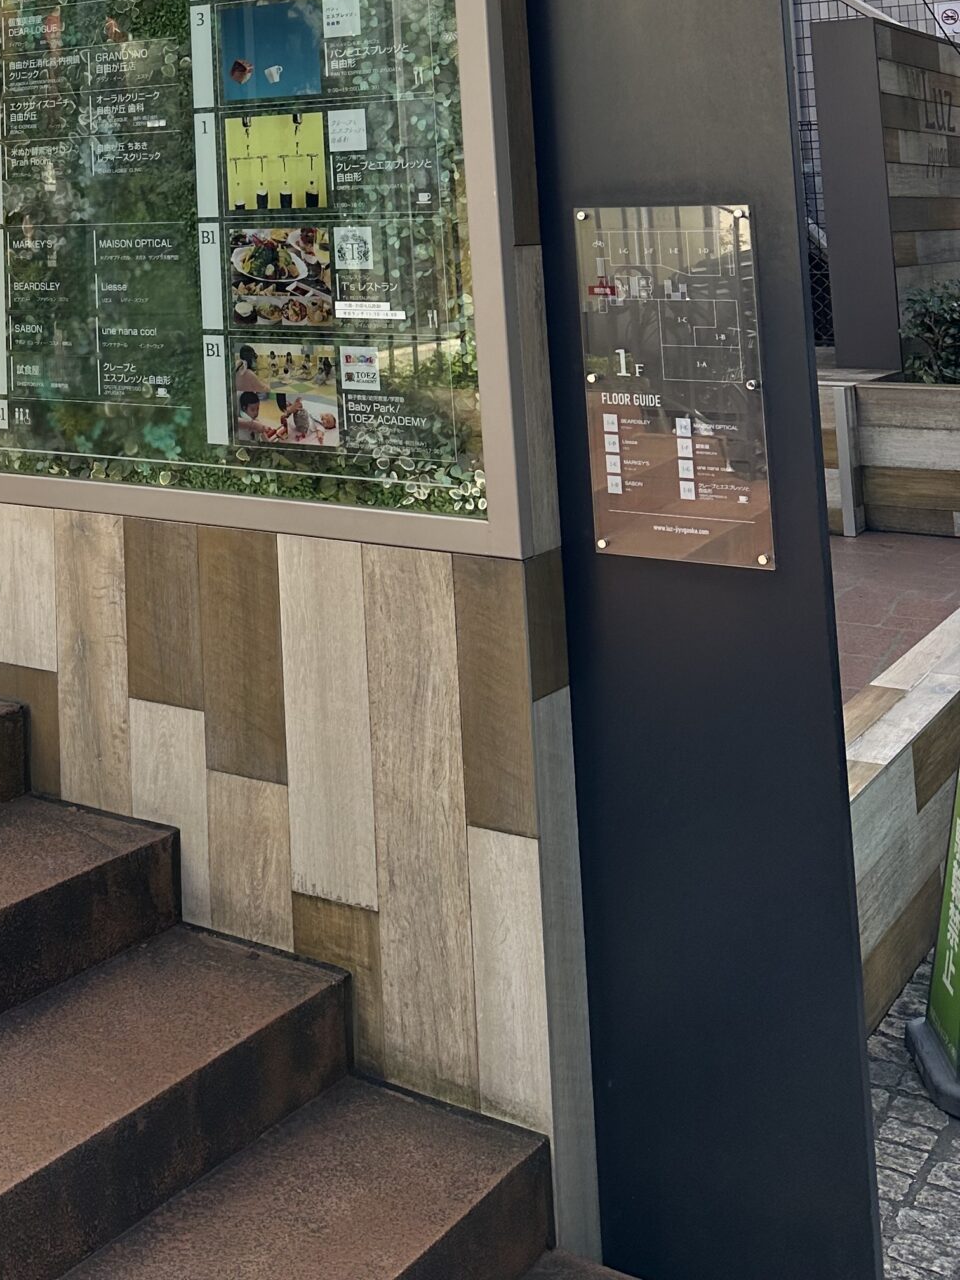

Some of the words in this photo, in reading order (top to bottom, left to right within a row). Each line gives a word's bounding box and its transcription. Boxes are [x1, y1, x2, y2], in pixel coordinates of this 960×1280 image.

[196, 12, 205, 26] 3
[330, 43, 410, 59] パンとエスプレッソと
[96, 62, 136, 75] 自由が丘店
[330, 58, 356, 69] 自由形
[9, 70, 39, 81] クリニック
[96, 91, 160, 105] オーラルクリニーク
[9, 98, 71, 111] エクササイズコーチ
[97, 104, 126, 116] 自由が丘
[128, 103, 144, 114] 歯科
[10, 111, 37, 122] 自由が丘
[202, 121, 208, 134] 1
[127, 141, 147, 152] ちあき
[336, 159, 432, 172] クレープとエスプレッソと
[336, 172, 362, 183] 自由形
[99, 239, 133, 249] MAISON
[134, 238, 173, 249] OPTICAL
[201, 231, 216, 245] B1
[13, 239, 53, 250] MARKEY'S
[13, 281, 61, 292] BEARDSLEY
[101, 282, 127, 292] Liesse
[342, 281, 355, 291] T's
[358, 281, 398, 293] レストラン
[14, 323, 43, 334] SABON
[102, 328, 116, 336] une
[118, 327, 138, 336] nana
[139, 327, 158, 337] cool
[206, 343, 222, 358] B1
[103, 362, 137, 374] クレープと
[103, 373, 171, 385] エスプレッソと自由形
[355, 371, 377, 380] TOEZ
[601, 392, 631, 406] FLOOR
[633, 392, 662, 407] GUIDE
[348, 402, 372, 414] Baby
[348, 413, 375, 424] TOEZ
[377, 415, 428, 427] ACADEMY
